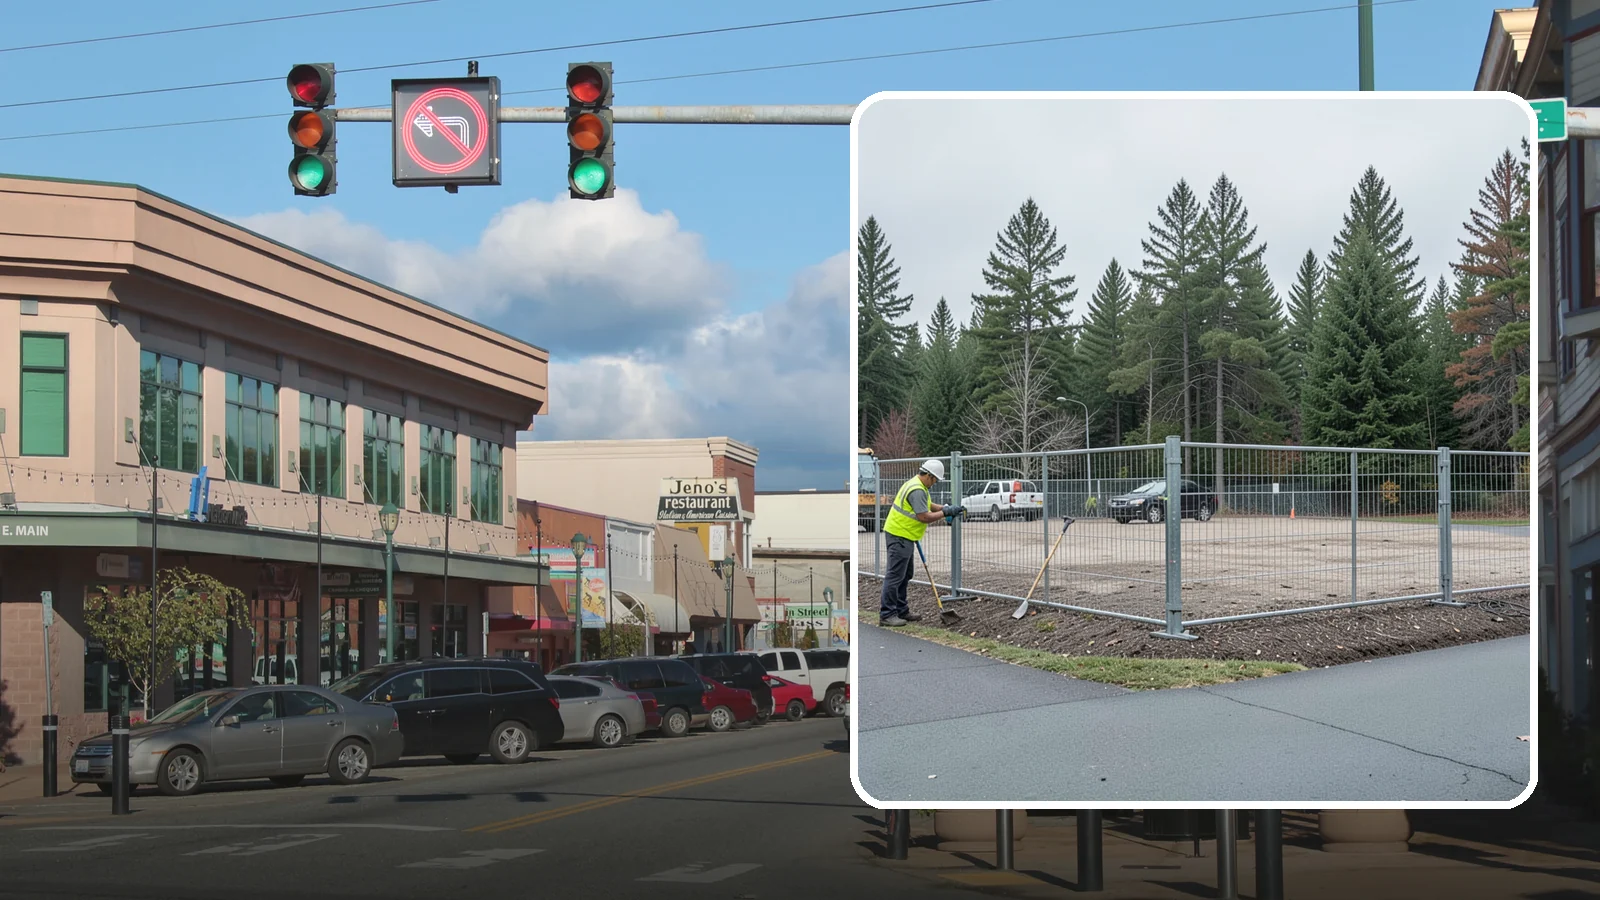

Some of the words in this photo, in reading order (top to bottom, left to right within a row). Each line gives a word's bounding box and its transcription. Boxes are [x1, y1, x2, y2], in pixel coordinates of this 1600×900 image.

[669, 480, 727, 494] Jeno's
[665, 496, 731, 509] restaurant
[658, 509, 681, 520] Italian
[686, 509, 714, 520] American
[715, 508, 737, 519] Cuisine
[2, 525, 13, 536] E.
[15, 525, 49, 536] MAIN
[797, 607, 828, 617] Street
[791, 619, 824, 627] lass
